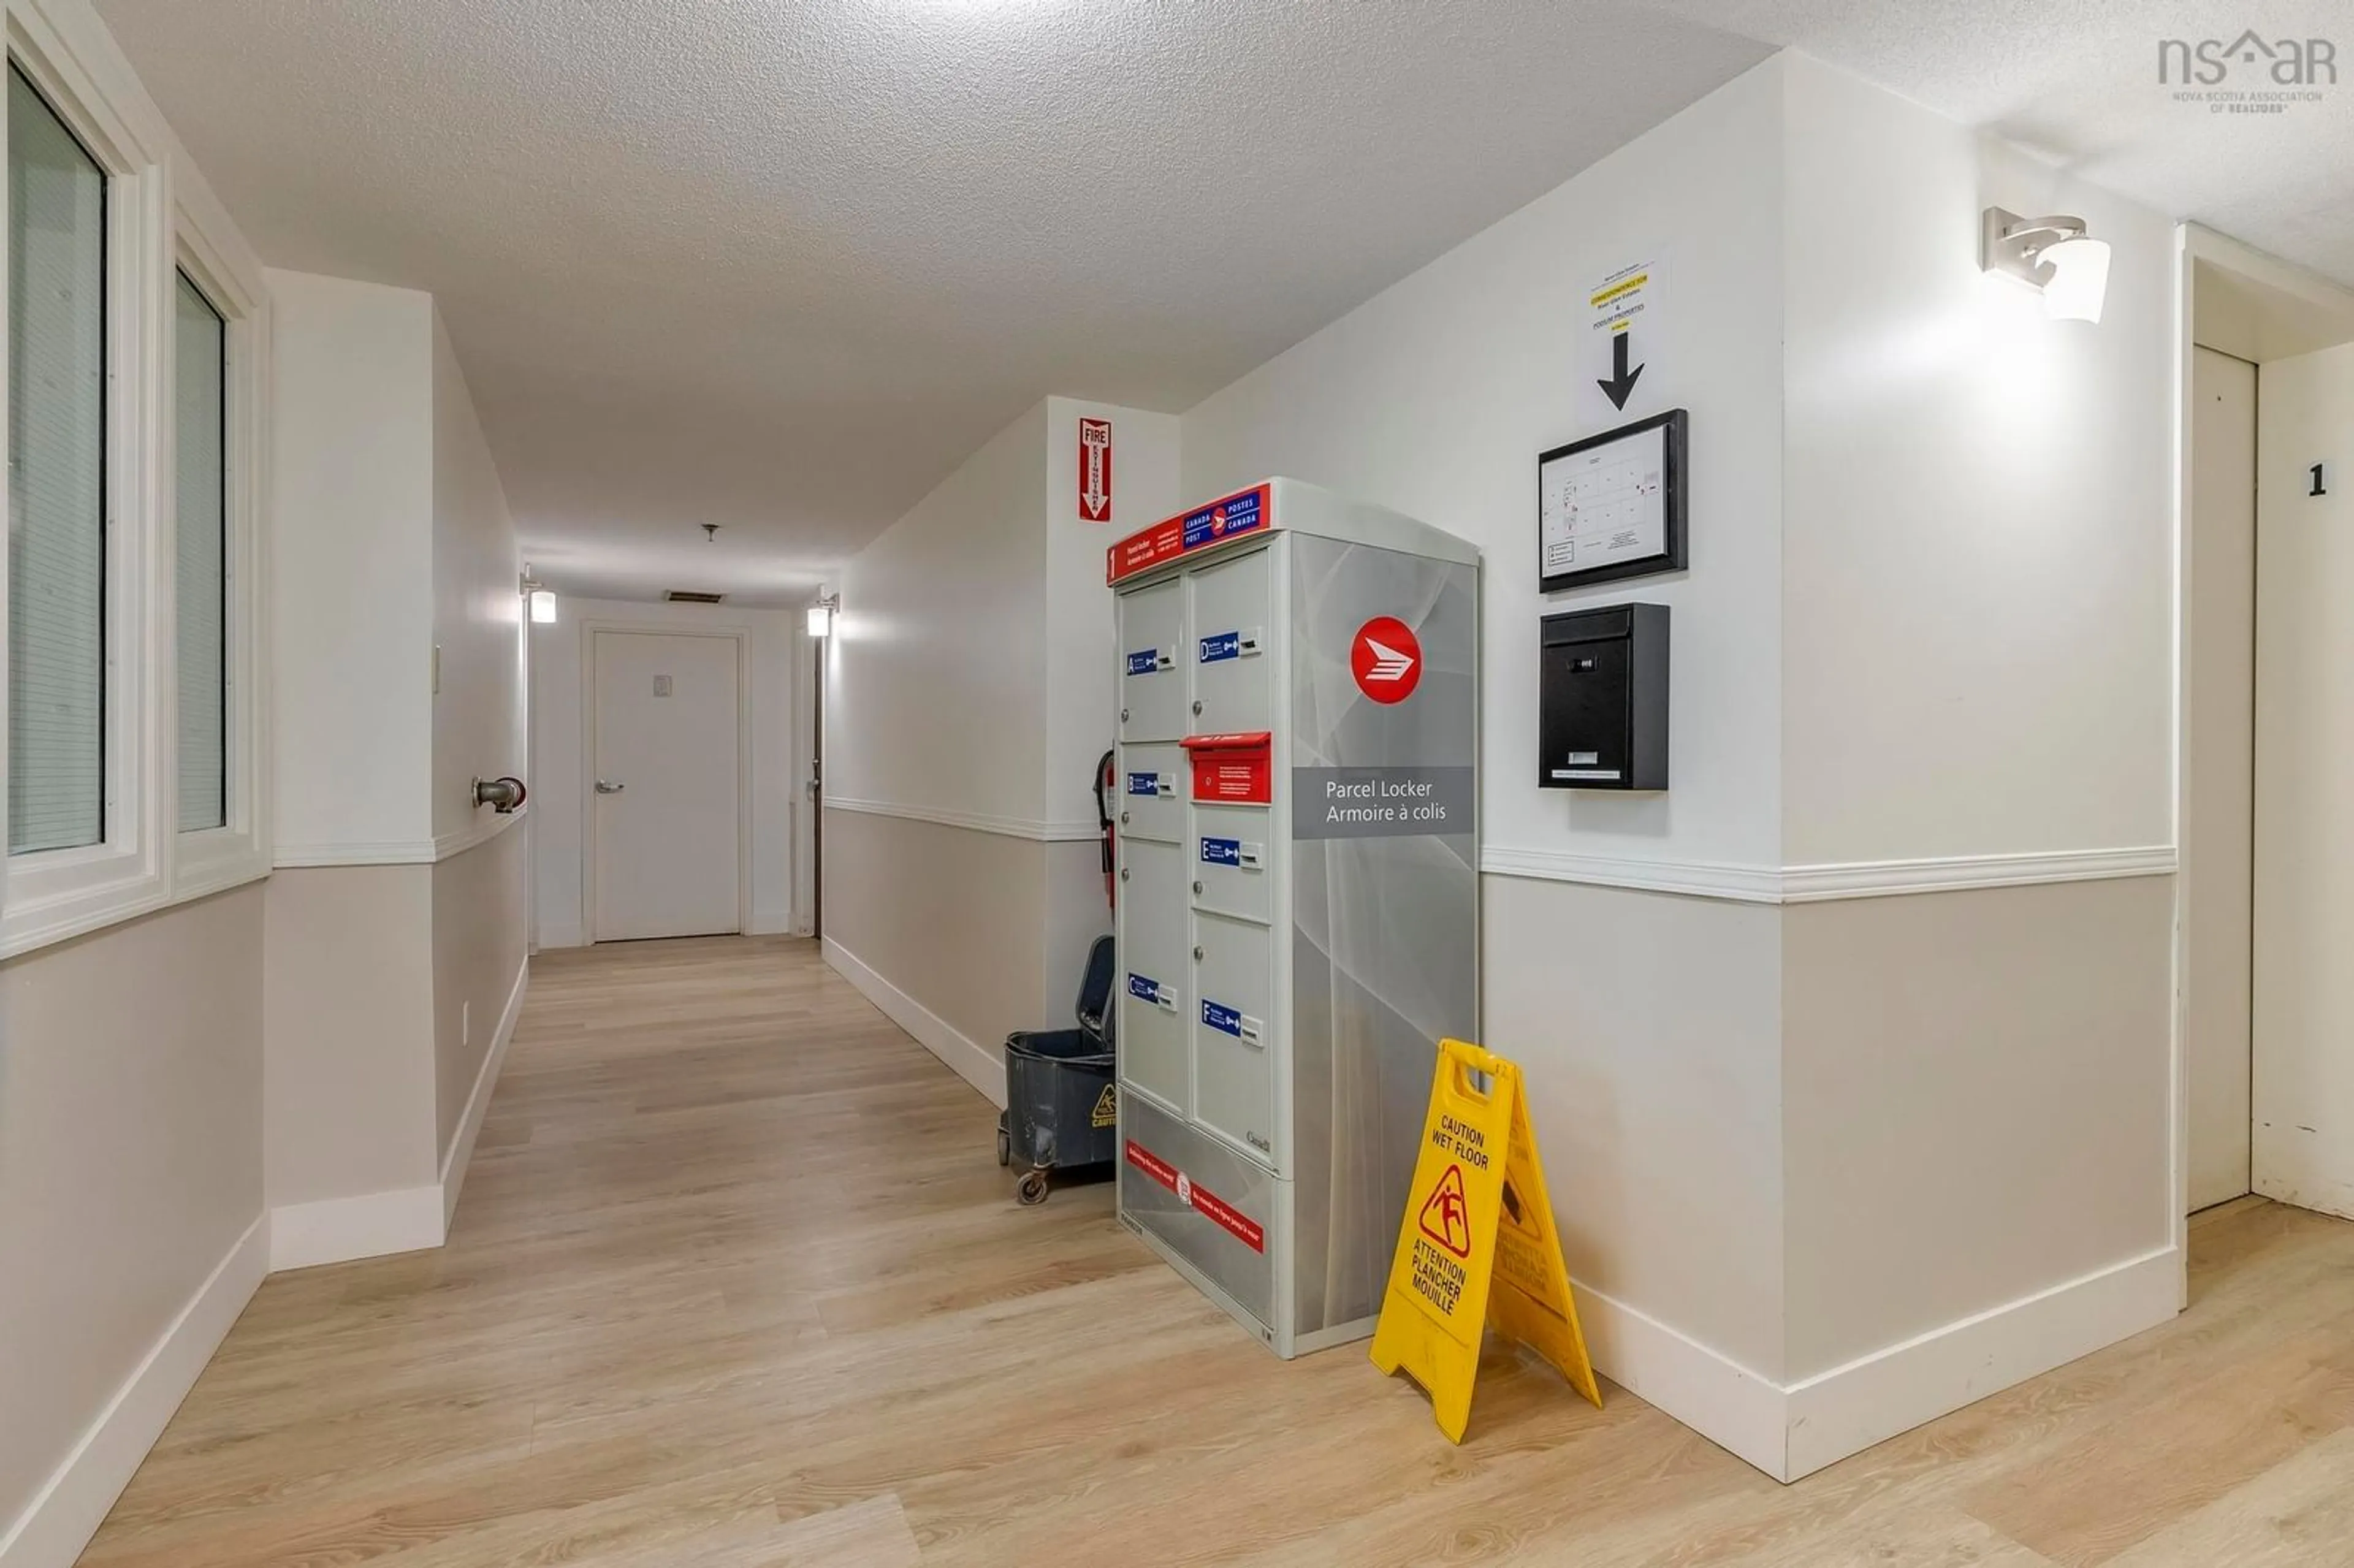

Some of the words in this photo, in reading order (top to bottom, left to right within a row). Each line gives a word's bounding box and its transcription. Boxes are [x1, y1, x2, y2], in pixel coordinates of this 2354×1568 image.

[1085, 428, 1106, 443] FIRE
[2309, 463, 2327, 497] 1
[1228, 498, 1254, 514] POSTES
[1186, 514, 1210, 530] CANADA
[1228, 514, 1257, 530] CANADA
[1186, 532, 1200, 544] POST
[1202, 642, 1209, 660] D
[1129, 657, 1133, 672] A
[1128, 775, 1134, 791] B
[1327, 779, 1376, 799] Parcel
[1381, 779, 1433, 797] Locker
[1326, 804, 1395, 823] Armoire
[1399, 803, 1408, 820] à
[1412, 802, 1446, 820] colis
[1203, 840, 1209, 859] E
[1129, 976, 1135, 993] C
[1204, 1003, 1211, 1022] F
[1441, 1114, 1485, 1148] CAUTION
[1432, 1127, 1453, 1151] WET
[1455, 1140, 1489, 1171] FLOOR
[1412, 1238, 1466, 1287] ATTENTION
[1412, 1254, 1460, 1303] PLANCHER
[1412, 1273, 1454, 1317] MOUILLE
